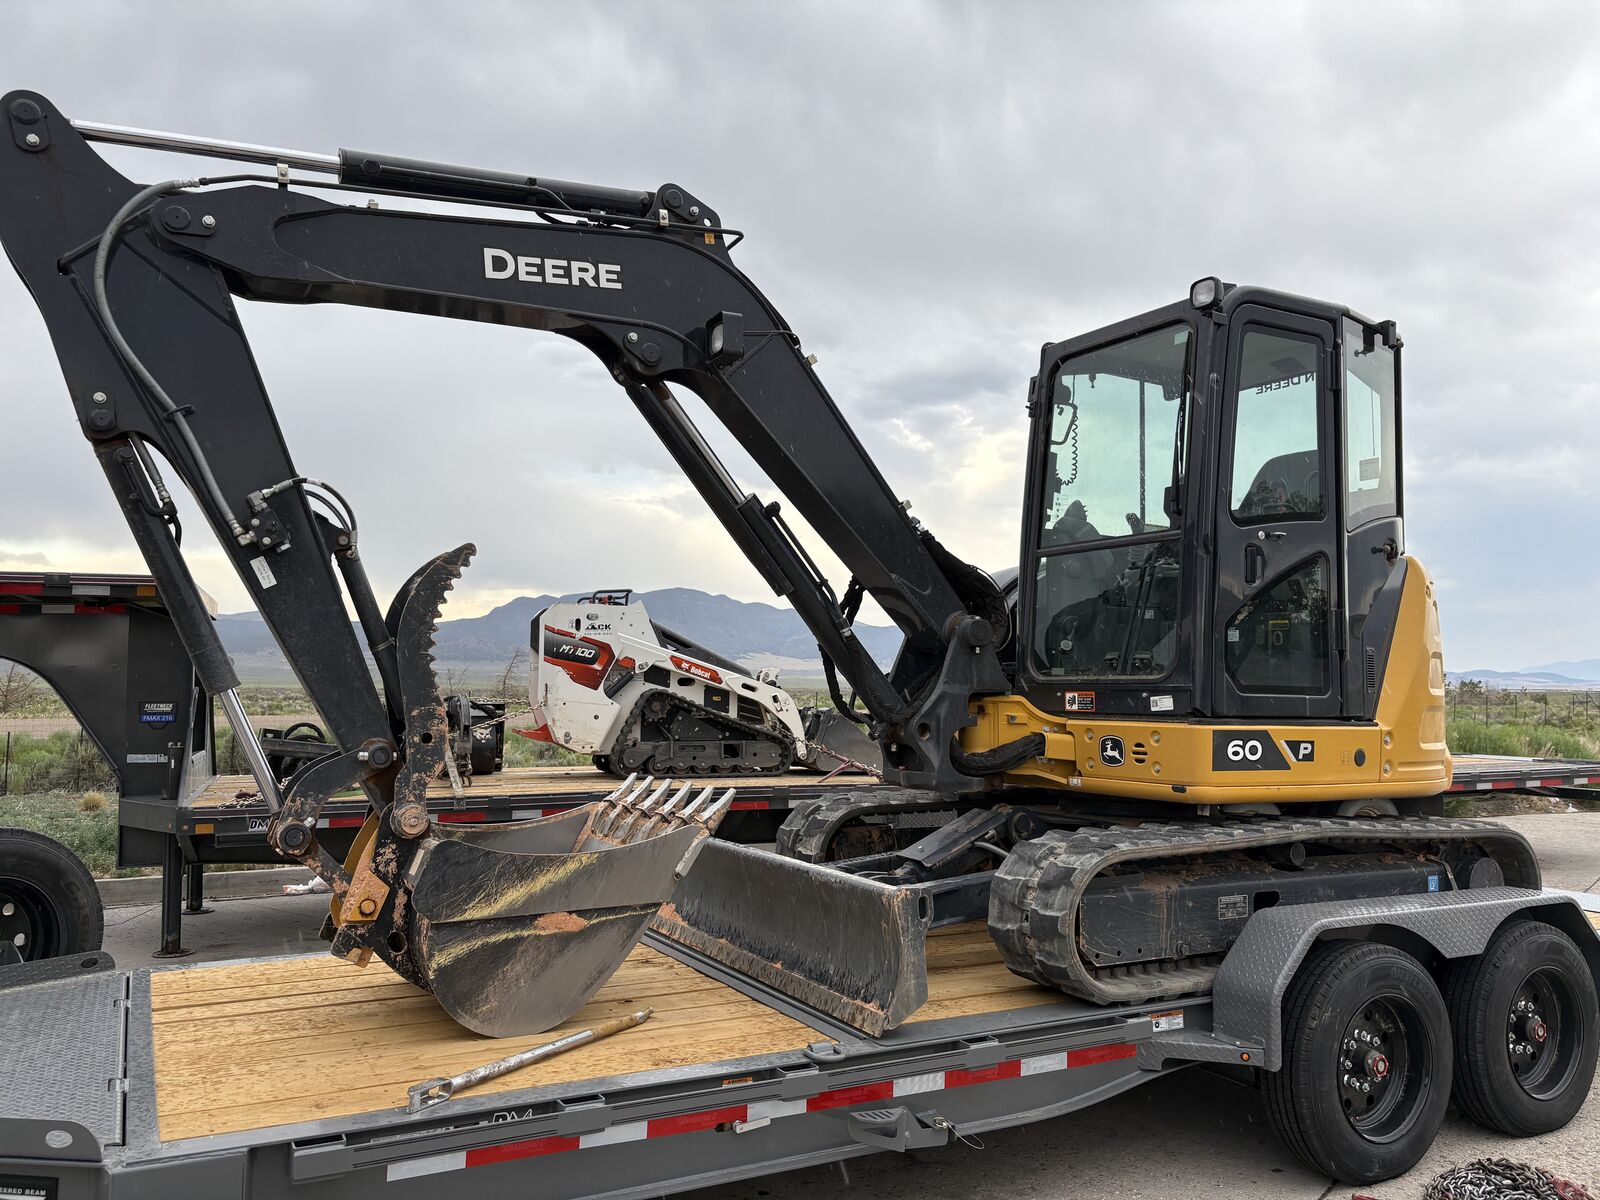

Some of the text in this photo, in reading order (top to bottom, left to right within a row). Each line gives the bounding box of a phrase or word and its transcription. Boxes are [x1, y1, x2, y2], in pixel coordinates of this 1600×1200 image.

[483, 247, 622, 290] DEERE
[690, 666, 711, 679] Bobcat
[1227, 739, 1312, 762] 60 P
[25, 1188, 47, 1196] BEAM
